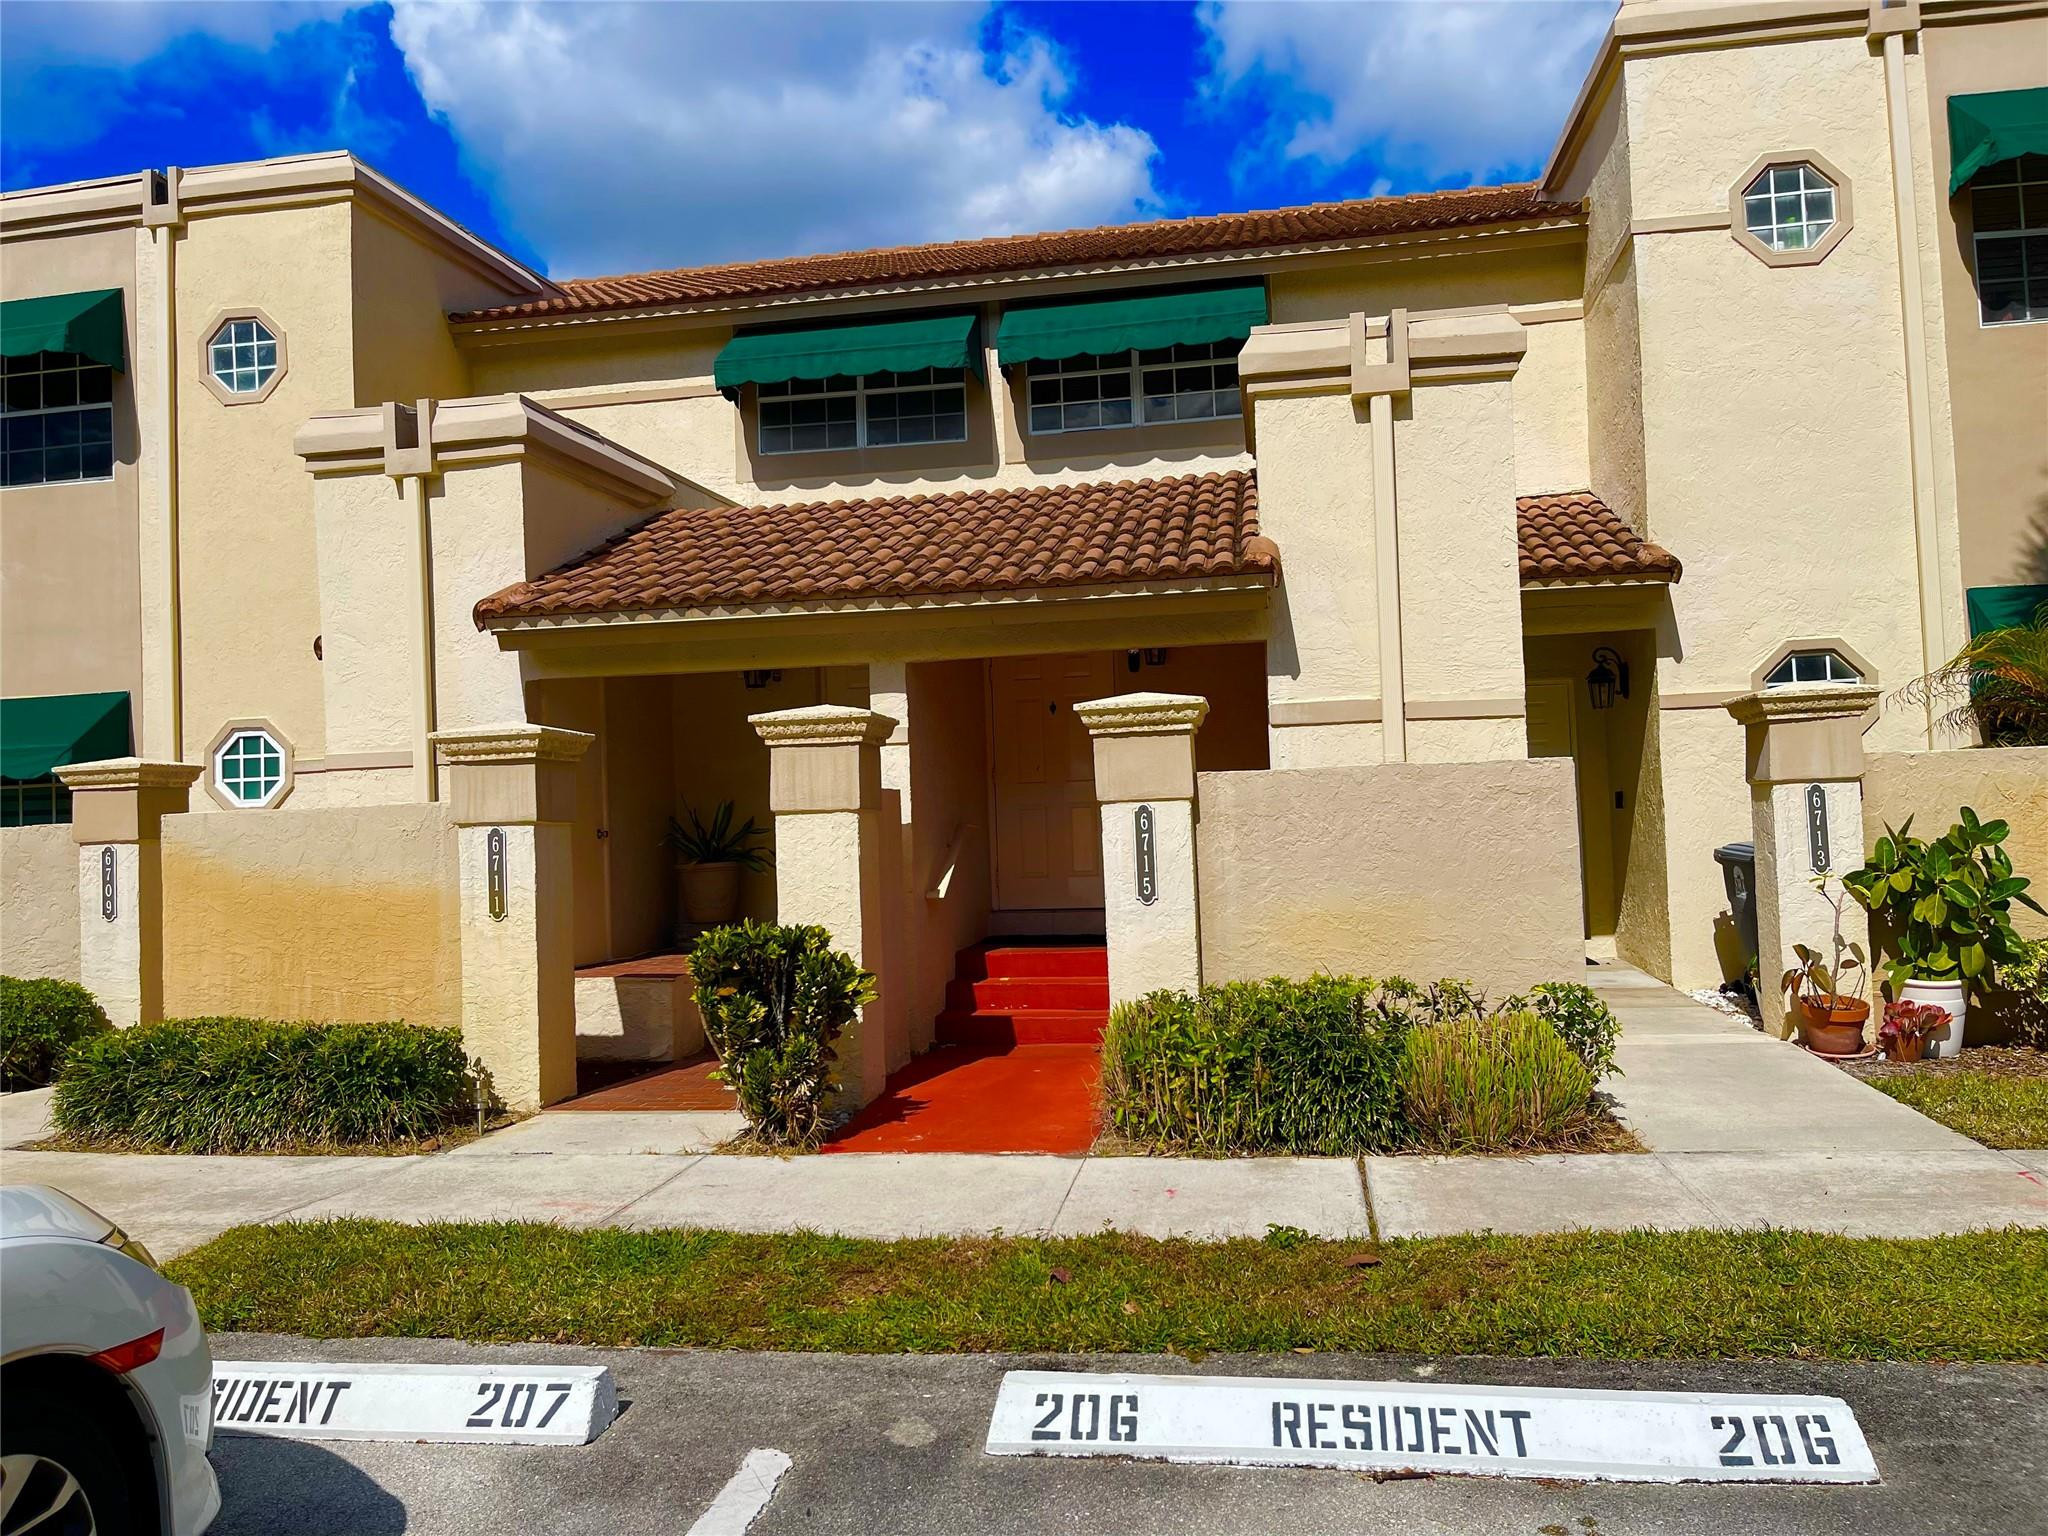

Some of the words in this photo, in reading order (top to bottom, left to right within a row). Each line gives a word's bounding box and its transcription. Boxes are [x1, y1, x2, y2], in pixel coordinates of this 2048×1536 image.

[1140, 812, 1151, 895] 6715
[1813, 792, 1825, 866] 6713
[492, 836, 500, 912] 6711
[466, 1383, 572, 1428] 207
[1032, 1393, 1138, 1441] 206
[1272, 1401, 1531, 1457] RESIDENT
[1710, 1415, 1840, 1466] 206
